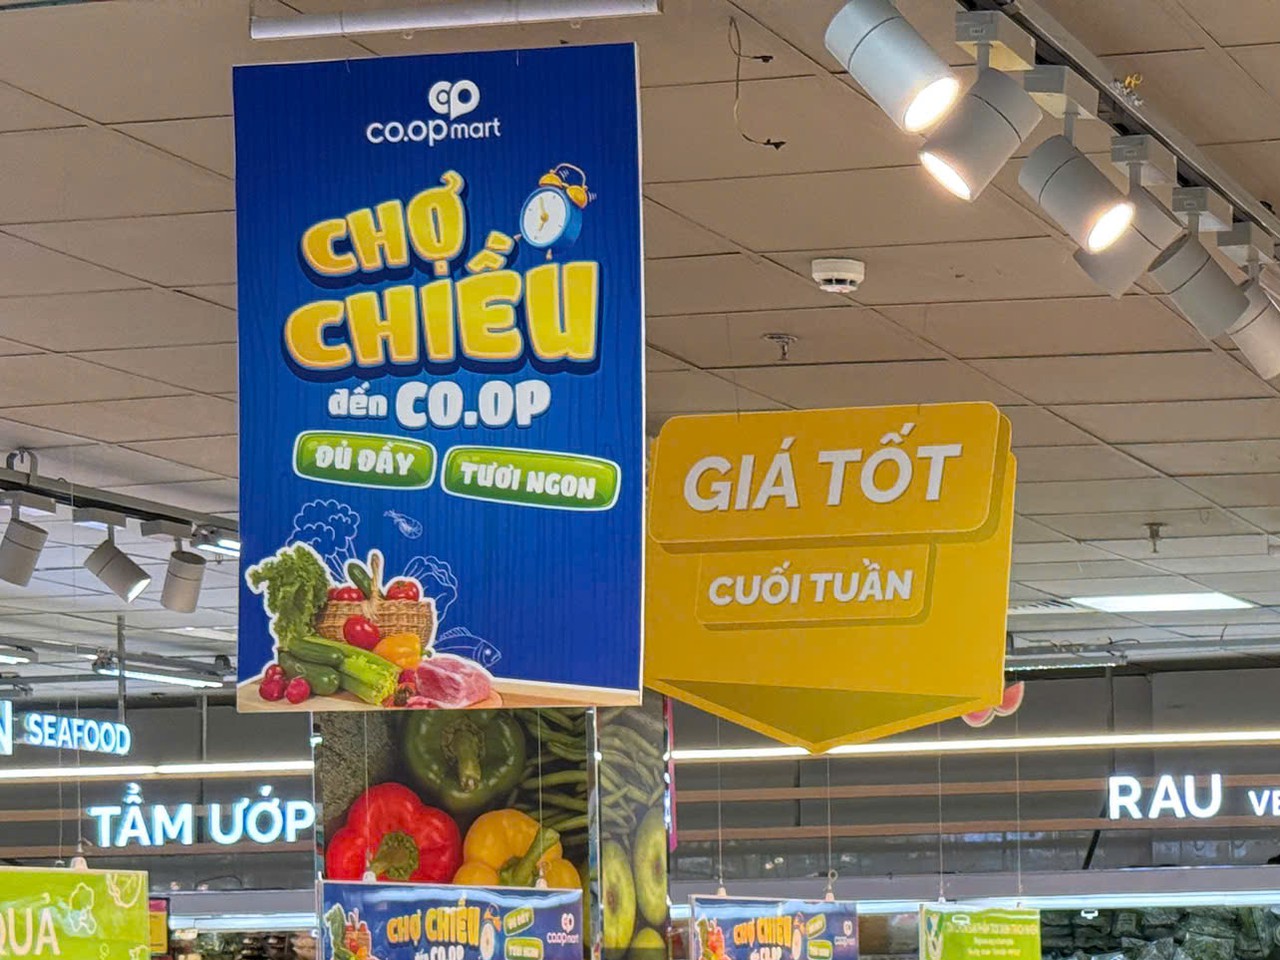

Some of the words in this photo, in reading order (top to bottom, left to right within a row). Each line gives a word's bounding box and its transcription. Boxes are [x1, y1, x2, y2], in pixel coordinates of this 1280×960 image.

[301, 170, 465, 276] CHỢ
[284, 230, 600, 371] CHIỀU
[327, 381, 389, 418] đến
[395, 379, 552, 428] CO.OP
[314, 440, 351, 471] ĐỦ
[357, 440, 415, 476] ĐẦY
[459, 459, 520, 491] TƯƠI
[526, 470, 597, 500] NGON
[683, 436, 800, 512] GIÁ
[817, 422, 963, 506] TỐT
[707, 560, 800, 606] CUỐI
[810, 557, 914, 603] TUẦN
[24, 712, 132, 756] SEAFOOD
[207, 783, 317, 846] ƯỚP
[1108, 773, 1223, 821] RAU
[0, 891, 61, 957] UẢ
